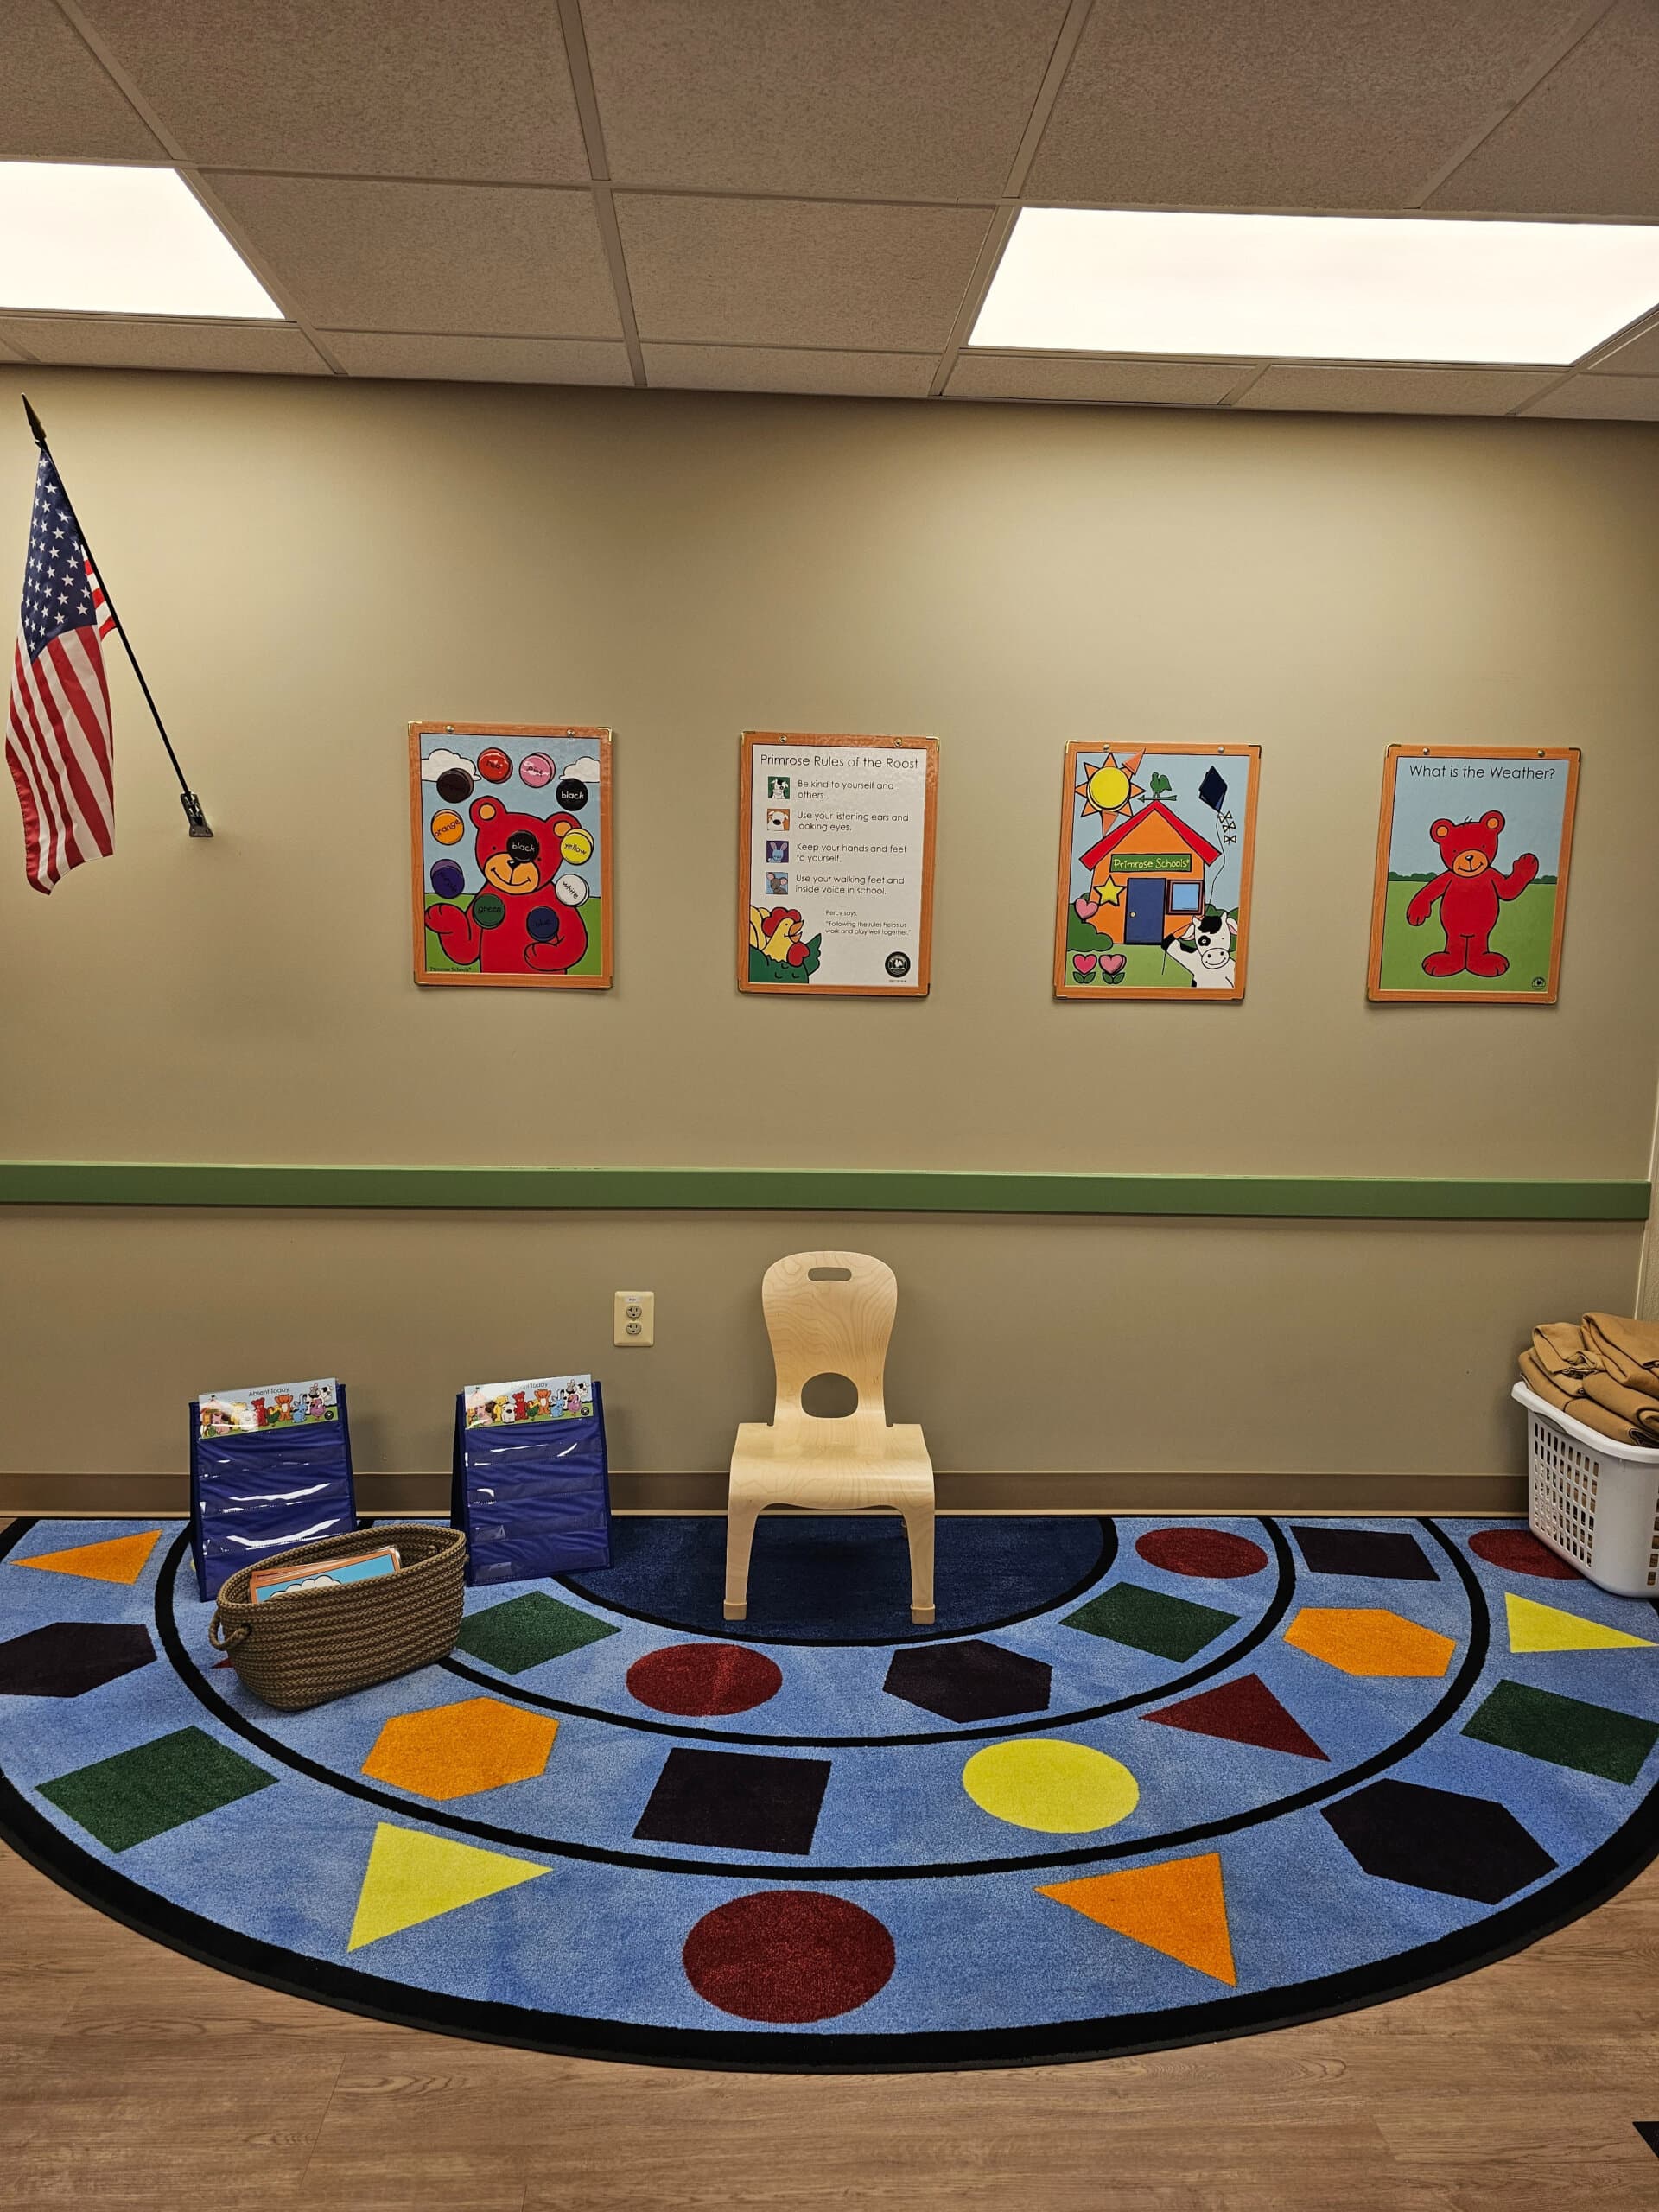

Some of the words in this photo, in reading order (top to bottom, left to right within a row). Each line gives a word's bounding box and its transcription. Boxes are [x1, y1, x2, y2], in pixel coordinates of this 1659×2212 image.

[760, 754, 810, 766] Primrose
[814, 755, 844, 767] Rules
[848, 757, 861, 767] of
[864, 757, 882, 768] the
[887, 758, 918, 769] Roost
[1409, 765, 1446, 777] What
[1450, 766, 1459, 778] is
[1463, 766, 1485, 779] the
[1490, 766, 1556, 779] Weather?
[798, 779, 809, 788] Be
[810, 779, 829, 788] kind
[831, 780, 840, 789] to
[842, 780, 874, 792] yourself
[877, 781, 894, 790] and
[561, 791, 584, 799] black
[798, 791, 826, 799] others.
[815, 812, 833, 821] your
[835, 812, 869, 823] listening
[891, 813, 909, 822] and
[434, 819, 461, 837] orange
[797, 822, 828, 832] looking
[830, 823, 852, 832] eyes.
[512, 841, 535, 852] black
[564, 842, 587, 855] yellow
[797, 842, 819, 853] Keep
[821, 844, 840, 853] your
[842, 843, 868, 852] hands
[870, 844, 887, 853] and
[890, 844, 907, 853] feet
[797, 854, 805, 862] to
[807, 854, 842, 863] yourself.
[1113, 858, 1154, 869] Primrose
[813, 875, 831, 884] your
[833, 875, 866, 886] walking
[868, 875, 885, 884] feet
[887, 876, 905, 885] and
[563, 880, 579, 899] white
[795, 885, 820, 893] inside
[847, 885, 855, 894] in
[856, 886, 887, 895] school.
[478, 906, 501, 915] green
